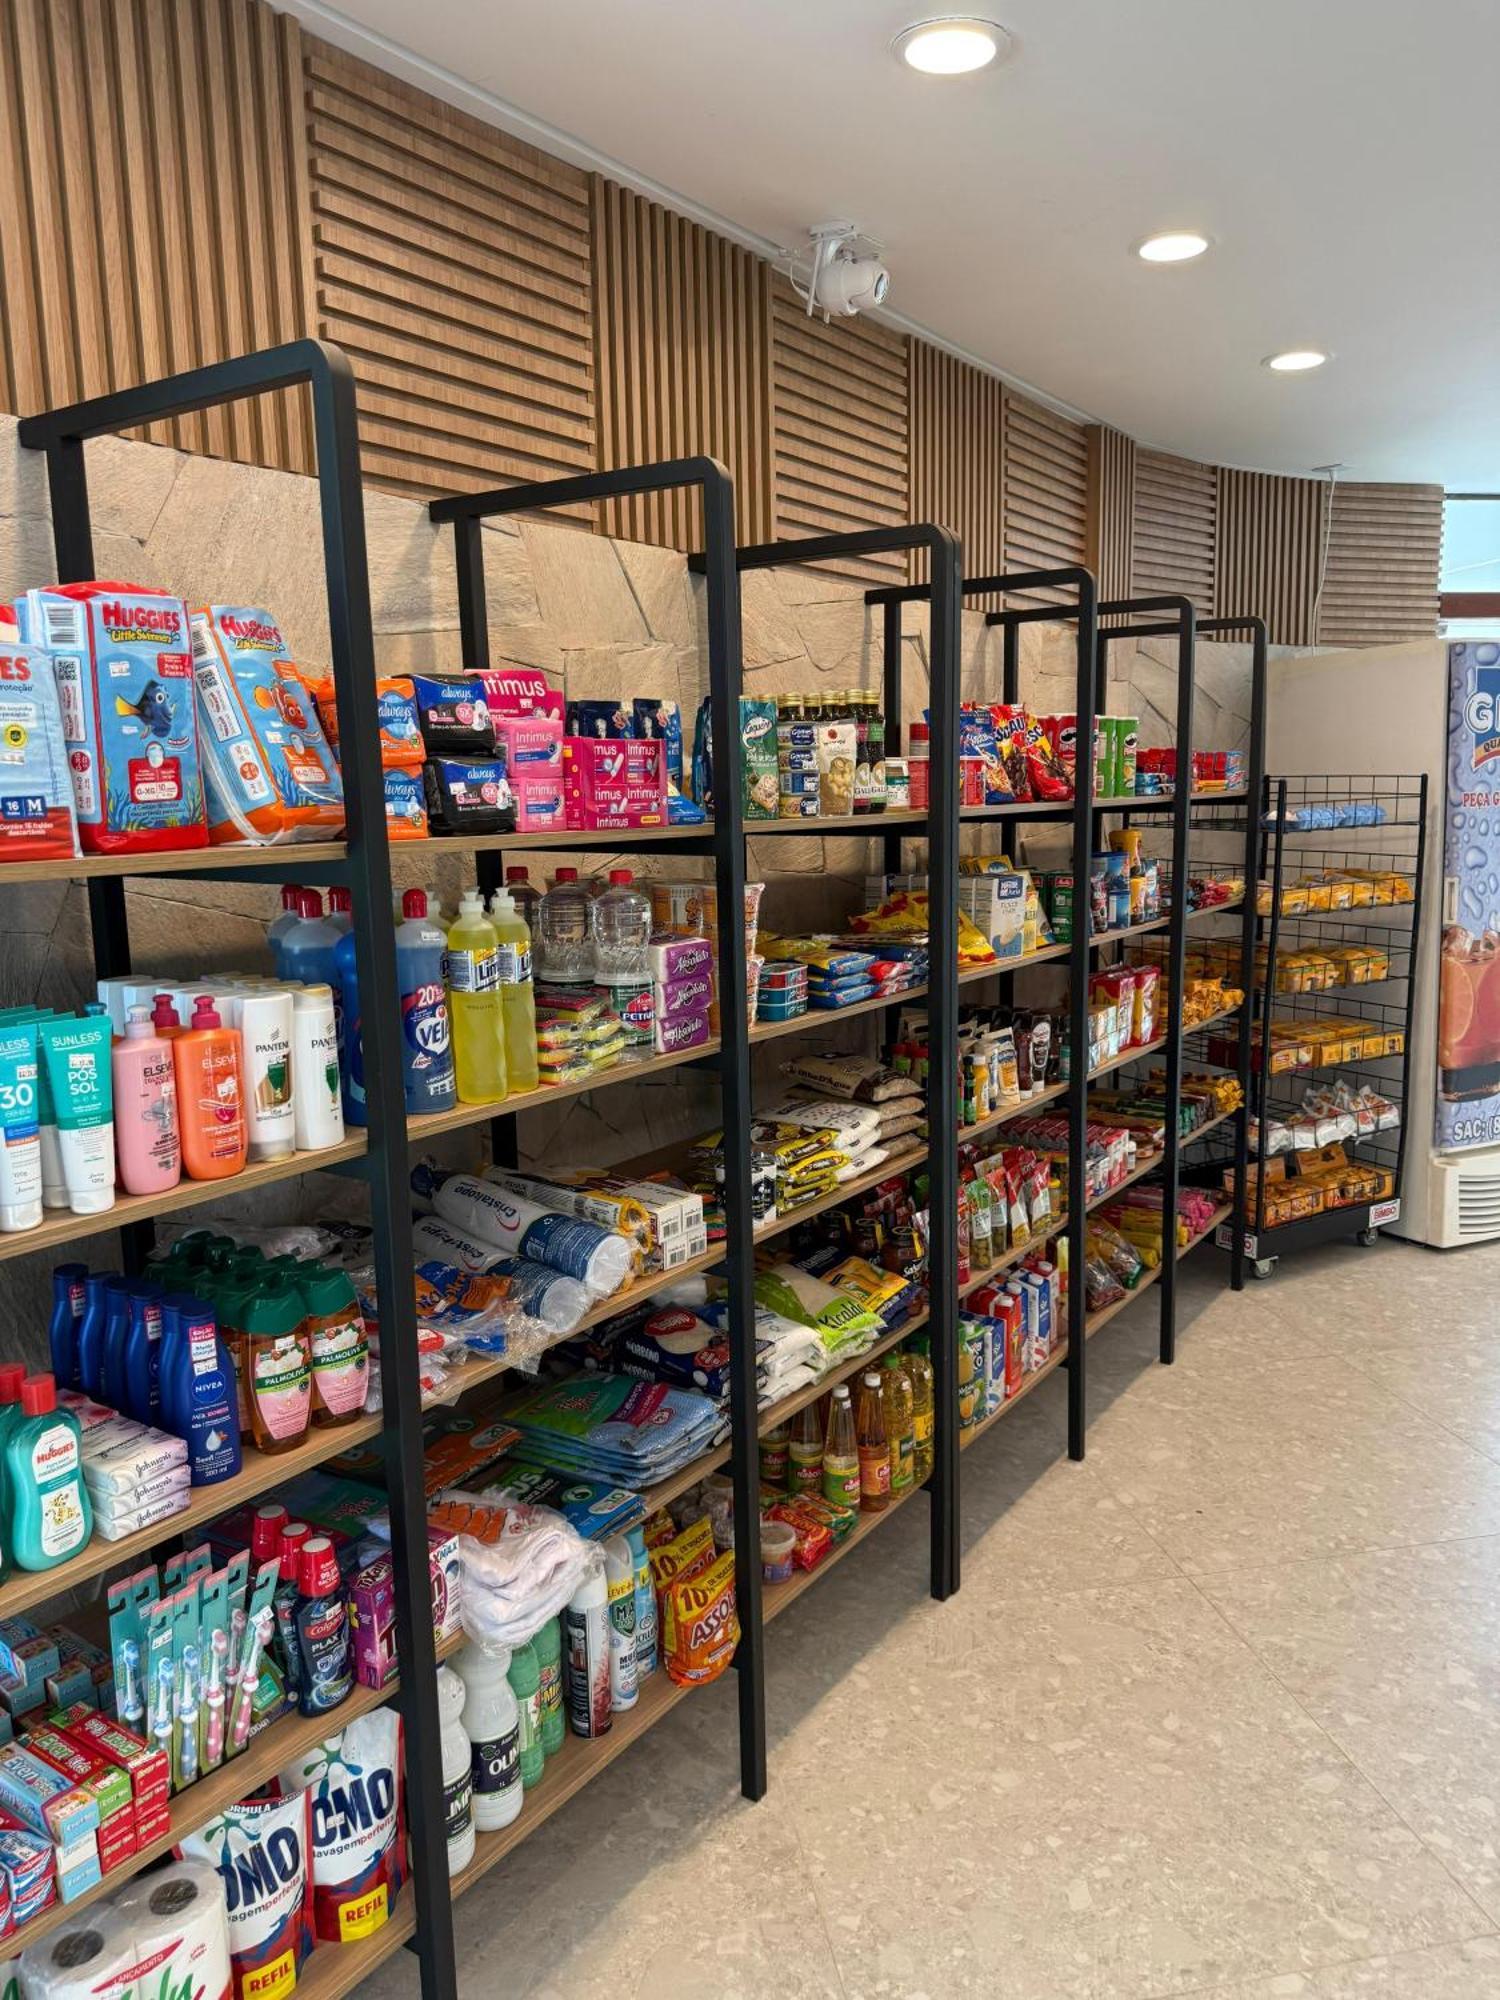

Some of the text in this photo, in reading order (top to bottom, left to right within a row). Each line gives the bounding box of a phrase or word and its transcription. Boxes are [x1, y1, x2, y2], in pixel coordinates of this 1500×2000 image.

[102, 601, 180, 632] HUGGIES
[441, 686, 474, 703] always
[378, 703, 412, 721] always
[516, 731, 553, 743] Intimus
[627, 743, 656, 756] Intimus
[468, 768, 496, 783] always
[526, 784, 557, 796] Intimus
[28, 799, 42, 812] M
[1462, 792, 1490, 809] PEÇA
[596, 816, 629, 828] Intimus
[0, 1037, 30, 1052] LESS
[51, 1031, 102, 1048] SUNLESS
[0, 1083, 34, 1110] 30
[69, 1082, 99, 1097] SOL
[1453, 1118, 1486, 1142] SAC:
[320, 1346, 362, 1364] PALMOLIVE
[264, 1369, 307, 1386] PALMOLIVE
[36, 1441, 75, 1465] HUGGIES
[135, 1451, 173, 1478] Johnson's
[134, 1476, 173, 1503] Johnson's
[136, 1500, 174, 1527] Johnson's
[311, 1633, 340, 1653] PLAX
[311, 1768, 395, 1848] OMO
[345, 1895, 385, 1923] REFIL
[249, 1960, 292, 1993] REFIL
